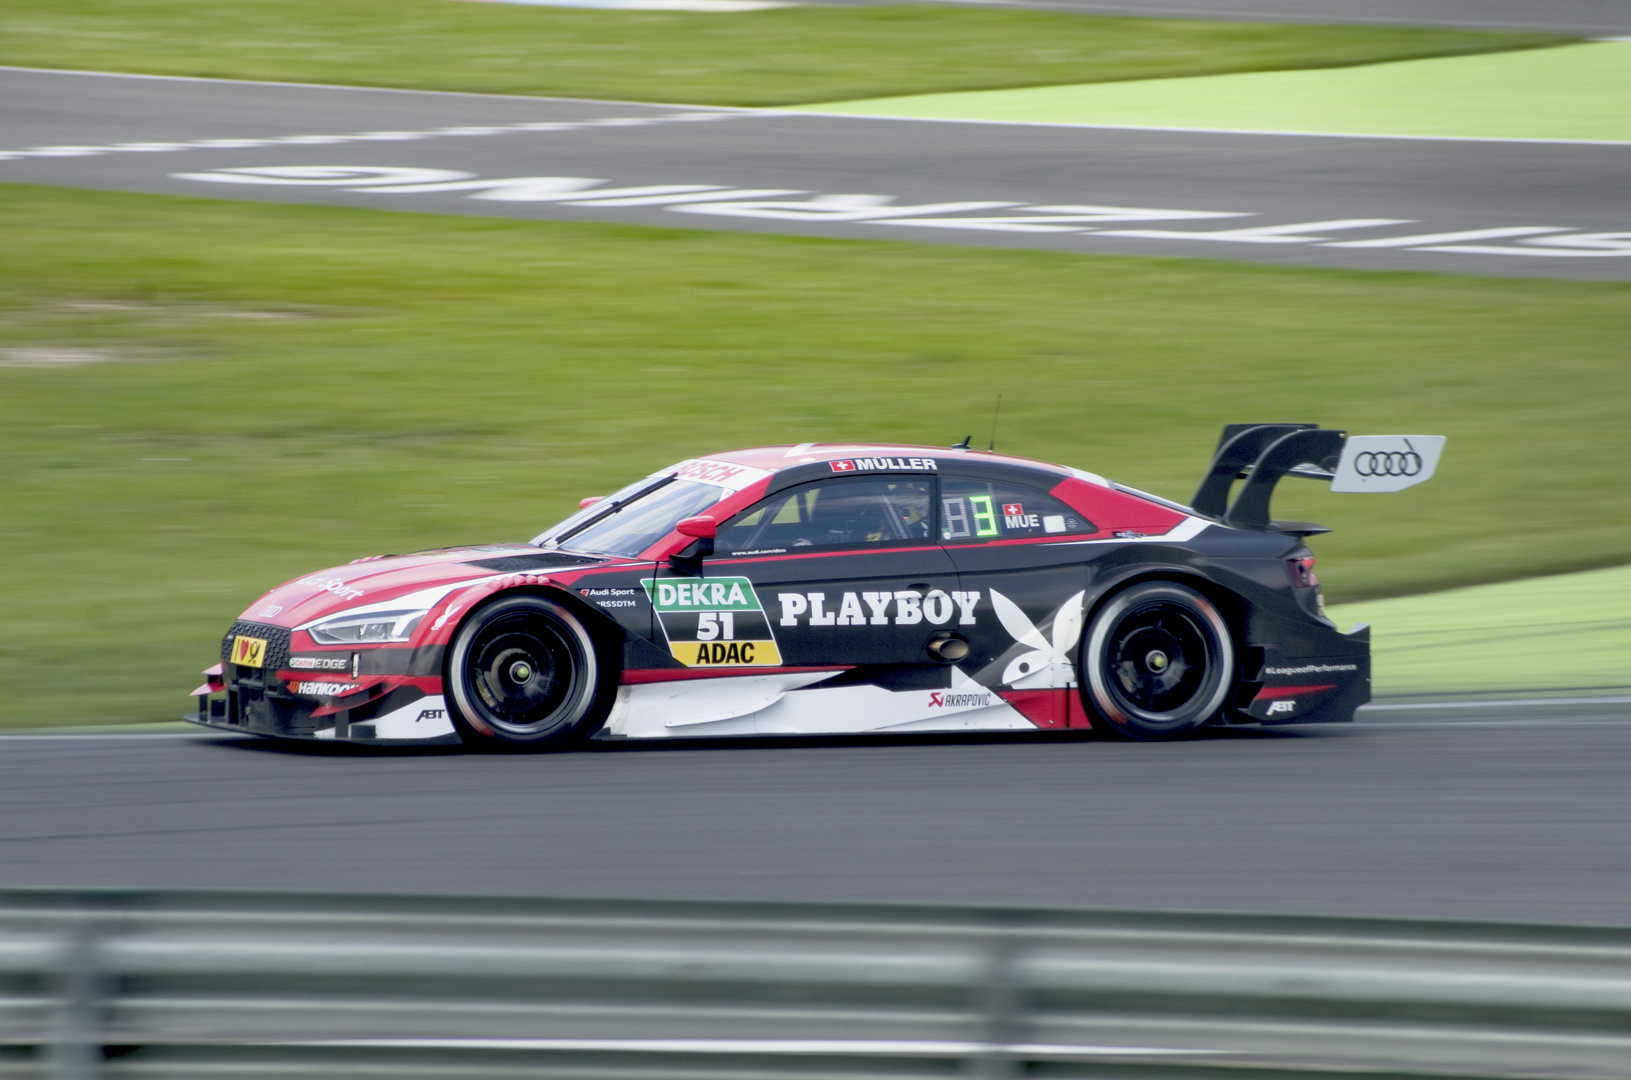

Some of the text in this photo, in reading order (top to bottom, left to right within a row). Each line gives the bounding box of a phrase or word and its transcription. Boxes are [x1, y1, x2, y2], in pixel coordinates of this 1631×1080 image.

[855, 457, 938, 471] MÜLLER
[1004, 515, 1040, 529] MUE
[731, 548, 787, 557] www.audi.com/dtm
[318, 578, 364, 601] Sport
[590, 588, 635, 597] Audi Sport
[658, 582, 748, 606] DEKRA
[596, 600, 636, 608] RS5DTM
[778, 590, 981, 626] PLAYBOY
[696, 612, 735, 641] 51
[696, 643, 756, 664] ADAC
[295, 658, 347, 670] Castrol EDGE
[1265, 664, 1357, 676] #LeagueofPerformance
[1266, 700, 1297, 716] ABT
[415, 709, 445, 723] ABT
